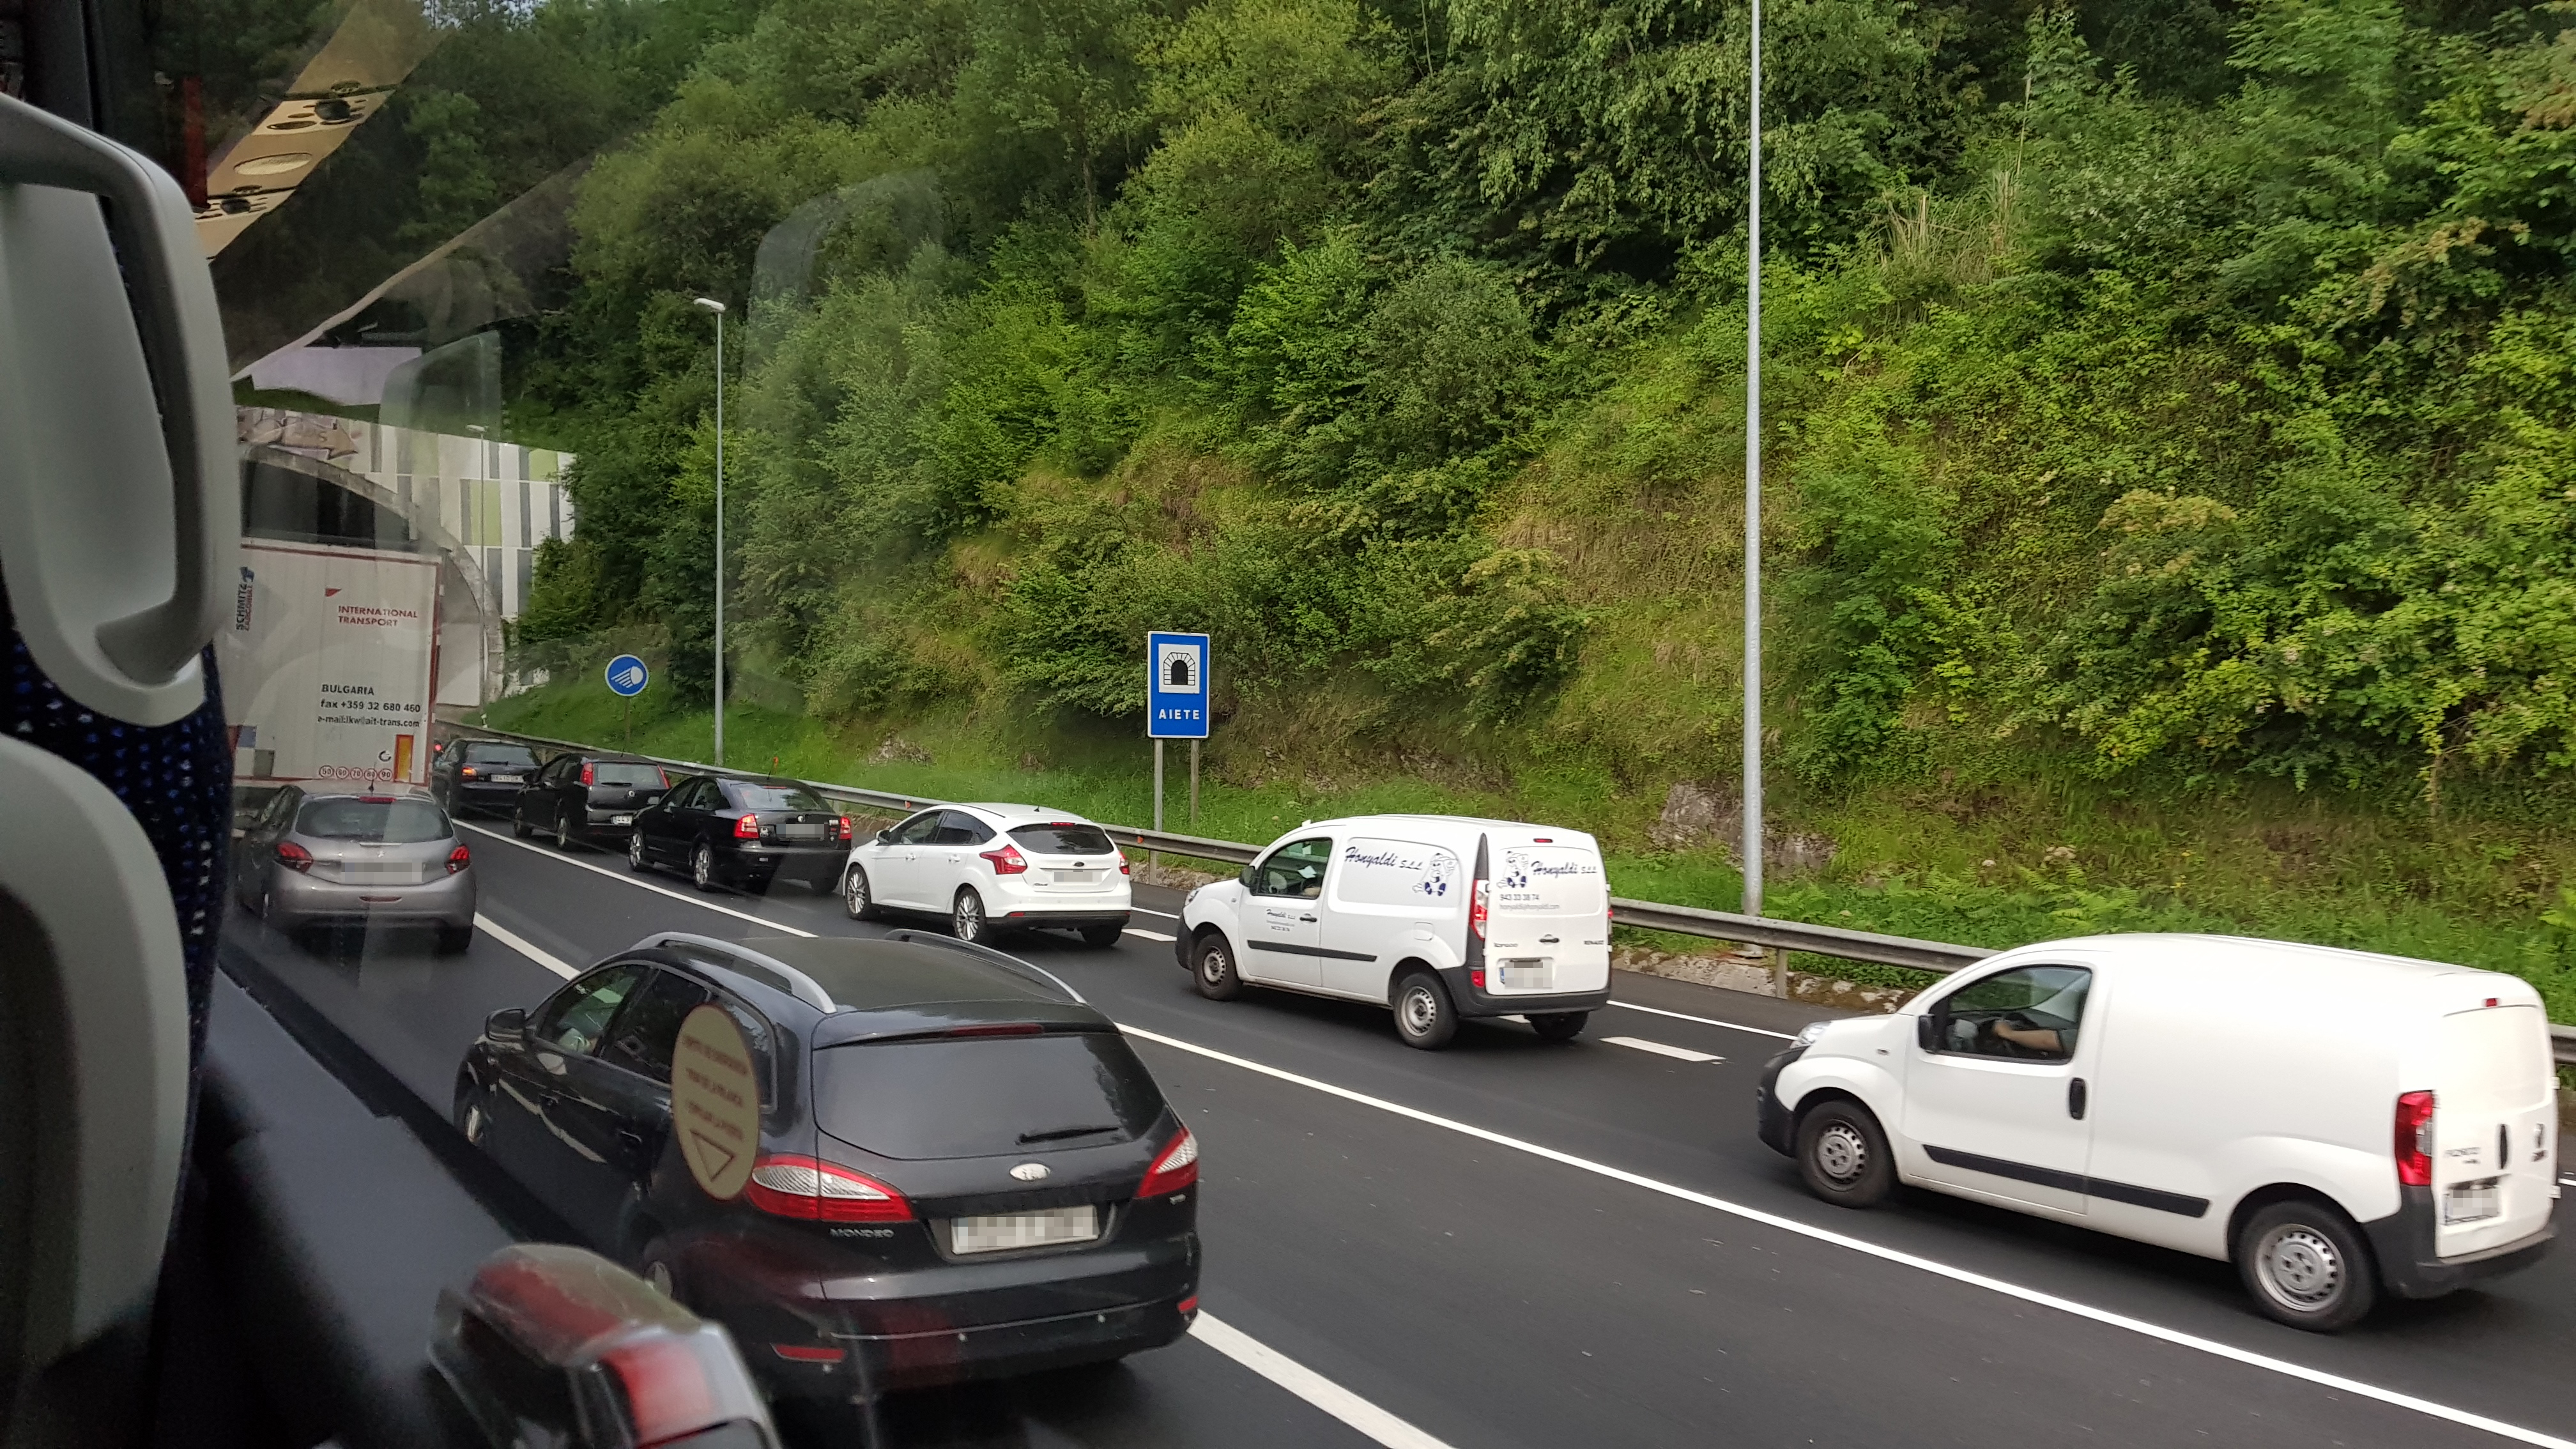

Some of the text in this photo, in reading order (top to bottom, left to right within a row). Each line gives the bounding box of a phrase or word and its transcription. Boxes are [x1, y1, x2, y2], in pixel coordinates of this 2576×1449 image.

[236, 583, 247, 631] SCHMITZ
[339, 606, 418, 618] INTERNATIONAL
[338, 616, 398, 627] TRANSPORT
[321, 684, 374, 696] BULGARIA
[320, 698, 338, 709] fax
[341, 700, 364, 710] +359
[367, 702, 379, 710] 32
[383, 702, 401, 712] 680
[1158, 709, 1200, 719] AIETE
[1345, 847, 1399, 868] Honyaldi
[1531, 861, 1578, 878] Honyaldi
[829, 1228, 894, 1239] MONDEO
